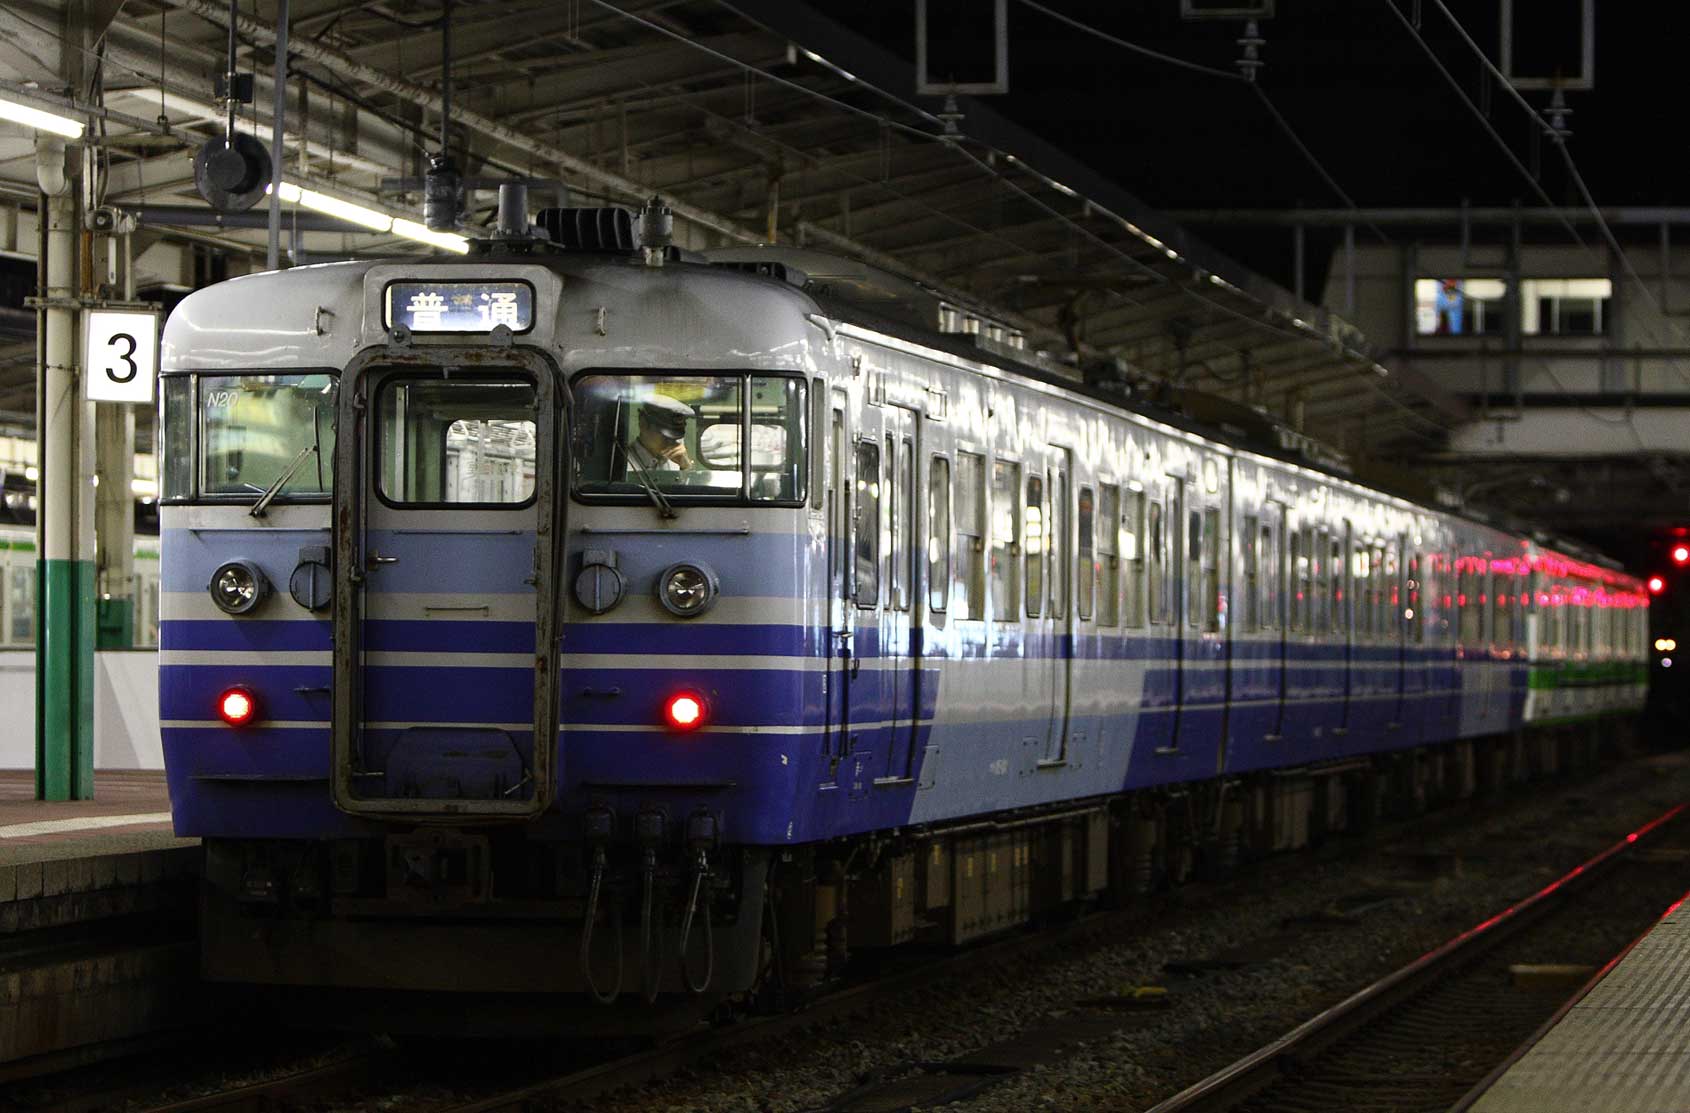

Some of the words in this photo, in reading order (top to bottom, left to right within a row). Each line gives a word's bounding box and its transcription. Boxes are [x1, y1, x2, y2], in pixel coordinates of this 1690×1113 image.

[406, 292, 518, 331] 普通
[106, 333, 137, 383] 3
[207, 391, 239, 408] N20
